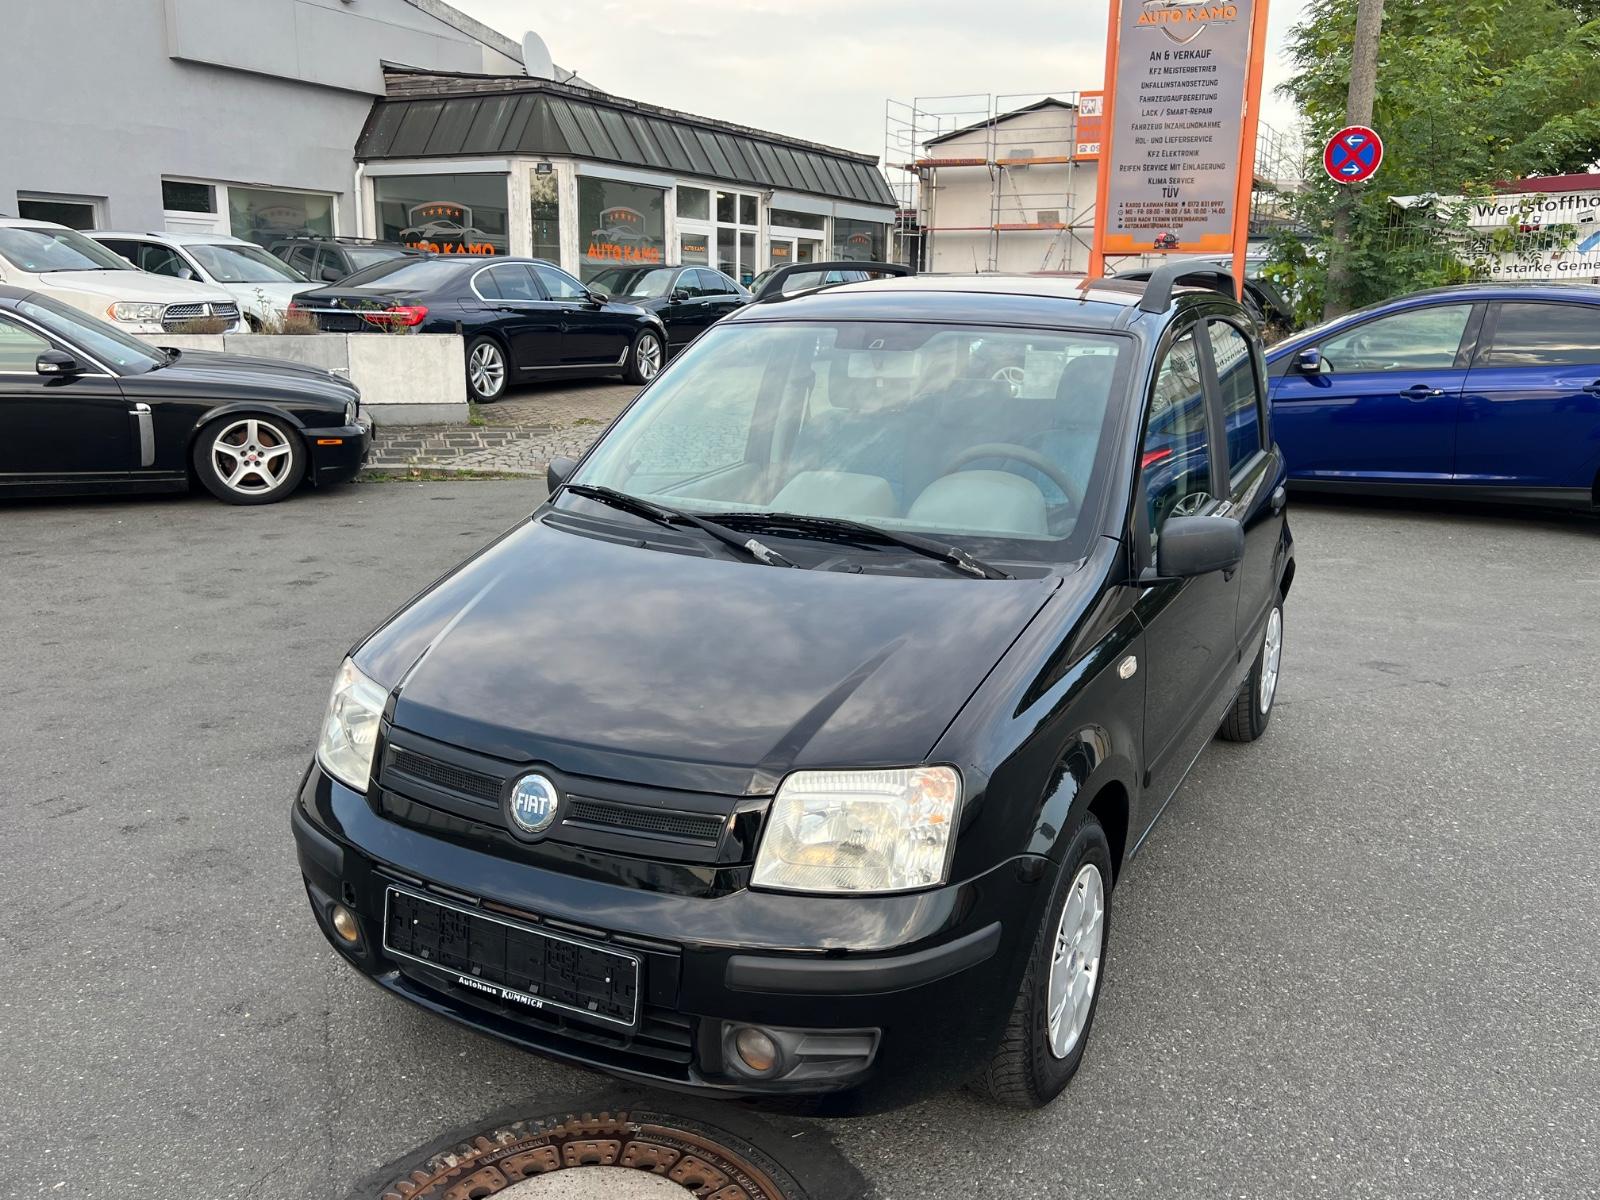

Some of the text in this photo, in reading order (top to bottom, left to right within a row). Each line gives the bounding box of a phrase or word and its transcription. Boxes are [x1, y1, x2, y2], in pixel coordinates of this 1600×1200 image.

[1138, 6, 1238, 24] AUTO KAMO
[1150, 49, 1212, 60] AN & VERKAUF
[1163, 66, 1216, 74] MEISTERBETRIEB
[1141, 80, 1218, 89] UNFALLINSTANDSETZUNG
[1139, 93, 1218, 103] FAHRZEUGAUFBEREITUNG
[1166, 108, 1212, 116] SMART-REPAIR
[1162, 186, 1179, 198] TÜV
[444, 242, 495, 256] KAMO
[587, 243, 659, 262] AUTO KAMO
[1506, 261, 1552, 274] starke
[516, 792, 548, 814] FIAT
[458, 976, 497, 994] Autohaus
